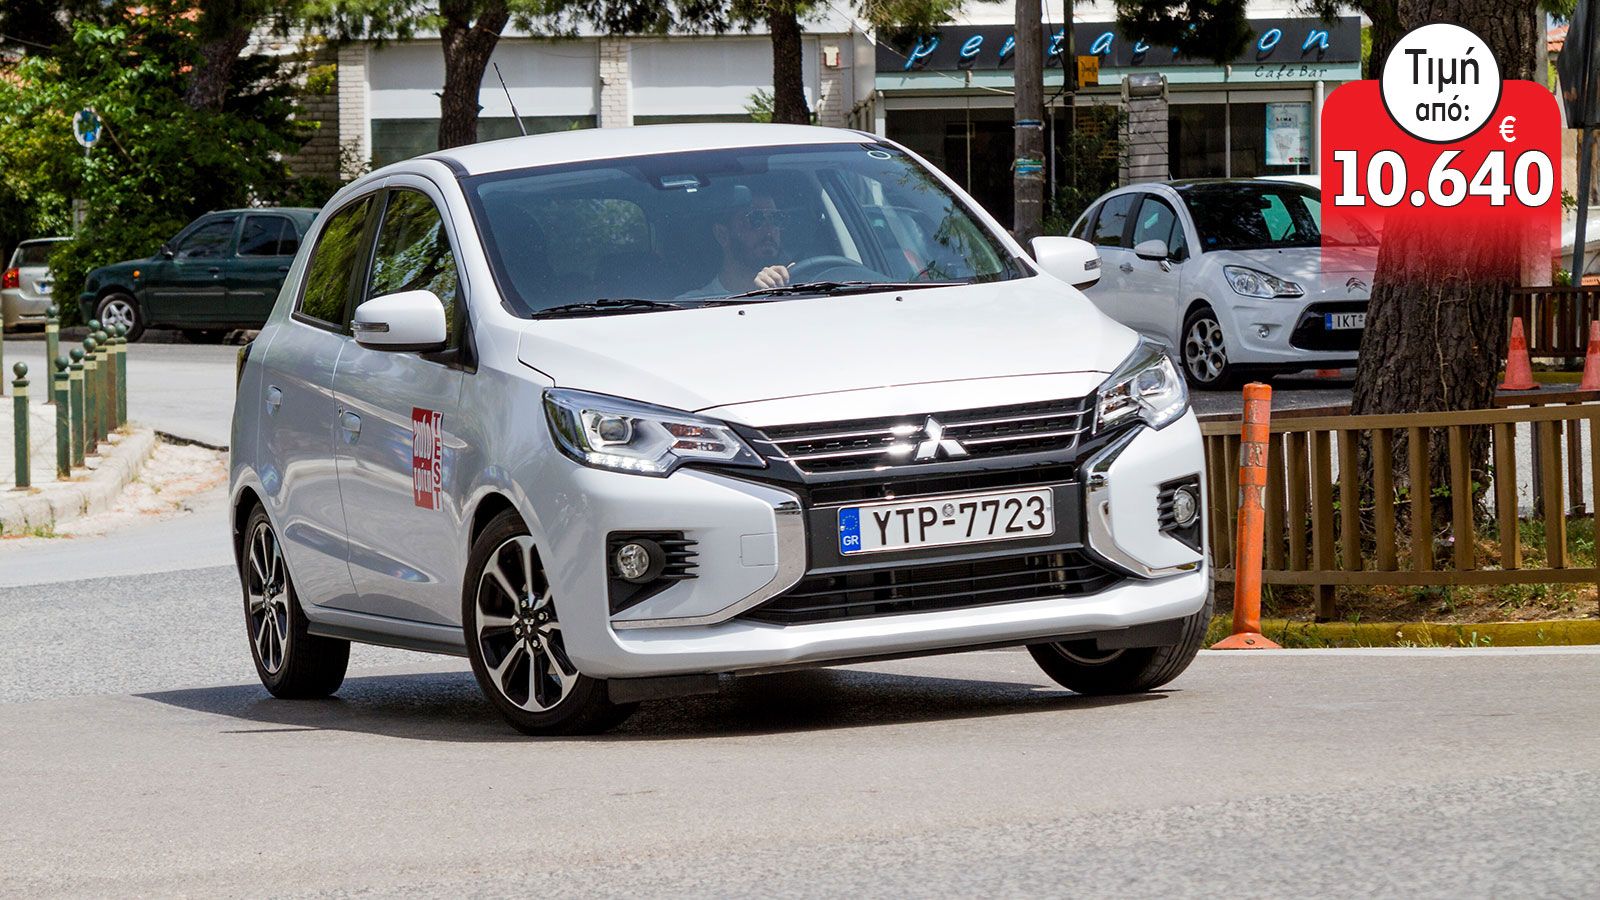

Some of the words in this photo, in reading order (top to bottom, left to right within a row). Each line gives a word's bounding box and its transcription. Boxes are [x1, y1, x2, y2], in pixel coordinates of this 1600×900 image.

[1254, 64, 1294, 80] Cafe
[1299, 65, 1328, 78] Bar
[433, 412, 441, 510] TEST
[842, 535, 860, 547] GR
